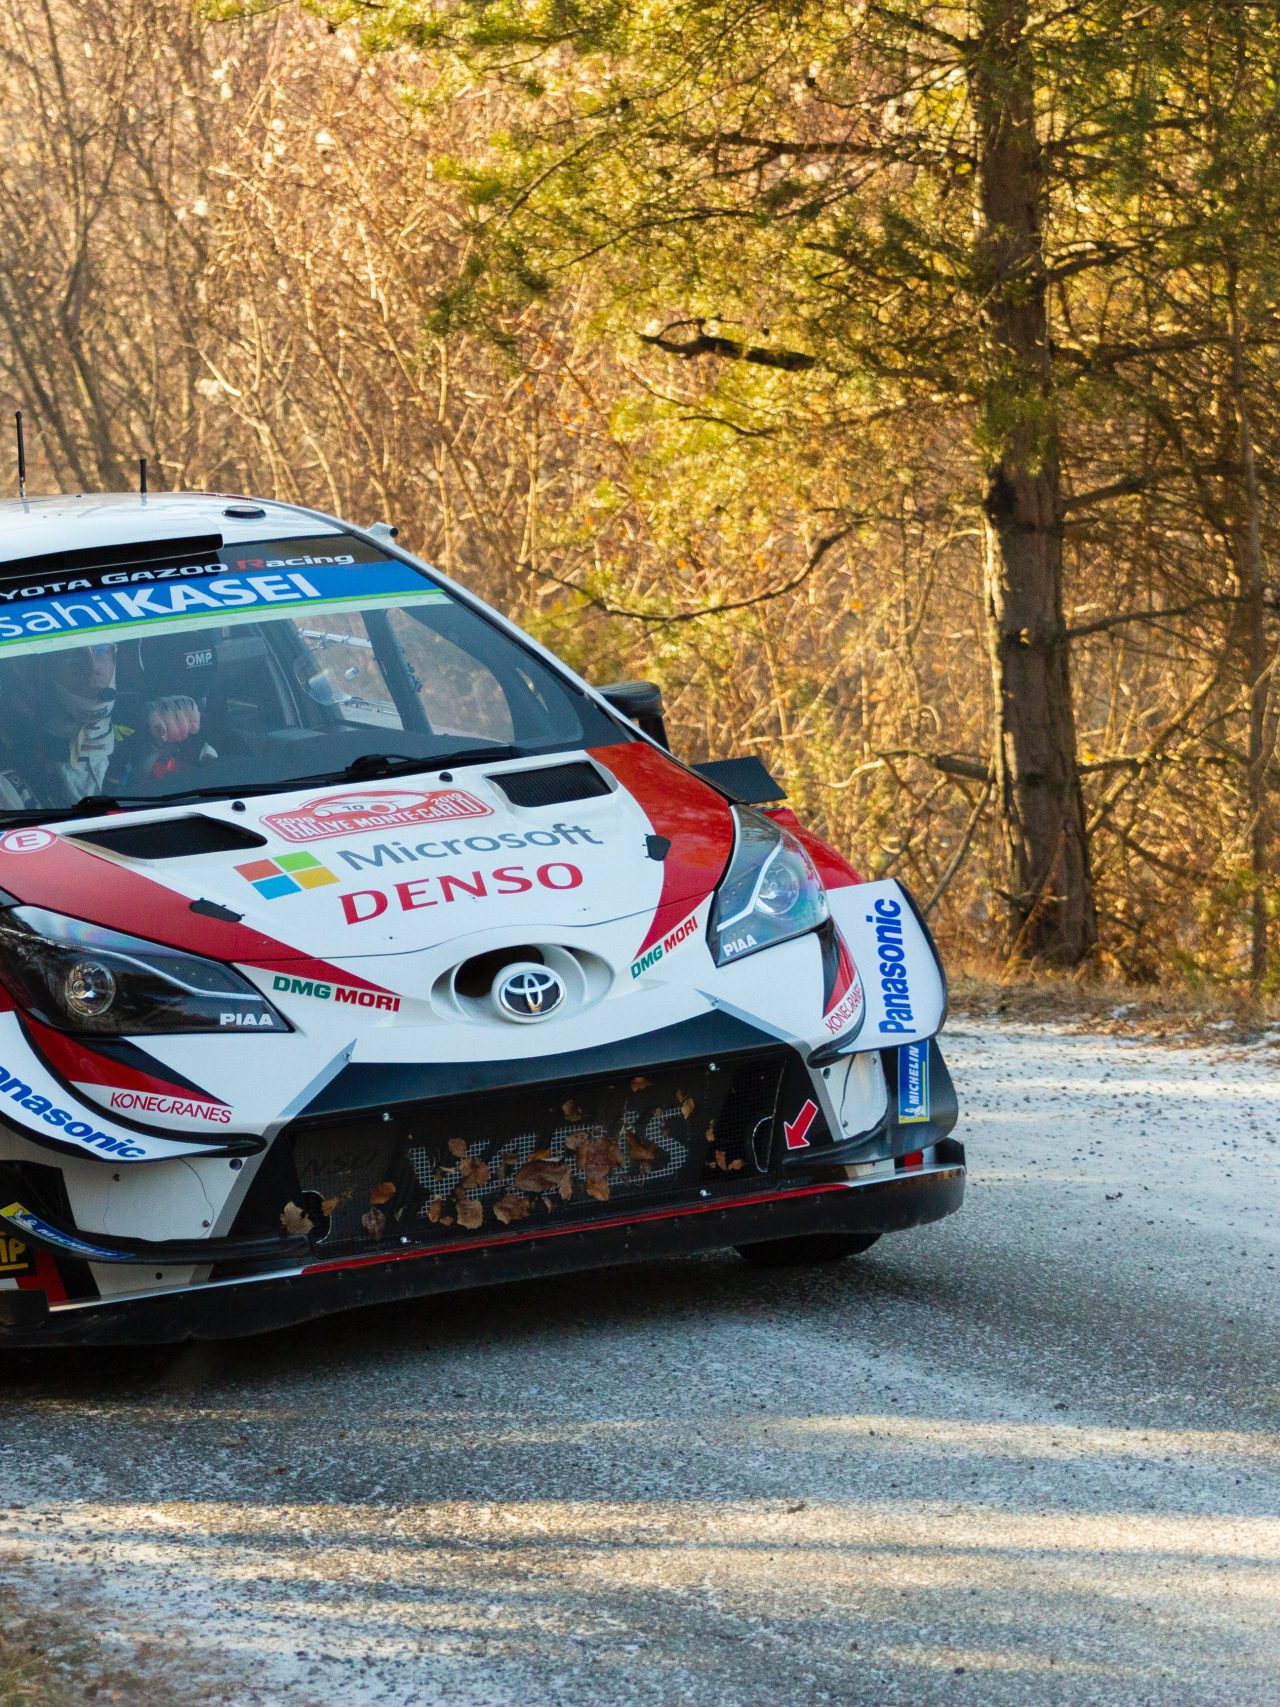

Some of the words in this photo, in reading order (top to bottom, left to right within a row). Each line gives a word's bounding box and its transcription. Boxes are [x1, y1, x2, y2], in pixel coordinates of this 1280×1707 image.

[100, 562, 229, 586] GAZOO
[235, 554, 356, 572] Racing
[185, 652, 212, 666] OMP
[16, 832, 38, 849] E
[281, 819, 352, 839] RALLYE
[336, 823, 605, 871] Microsoft
[338, 862, 583, 925] DENSO
[630, 945, 664, 980] DMG
[664, 916, 699, 954] MORI
[722, 934, 758, 958] PIAA
[865, 898, 917, 1034] Panasonic
[273, 974, 332, 1000] DMG
[334, 986, 401, 1012] MORI
[219, 1012, 274, 1027] PIAA
[908, 1046, 920, 1105] MICHELIN
[110, 1091, 233, 1124] KONECRANES
